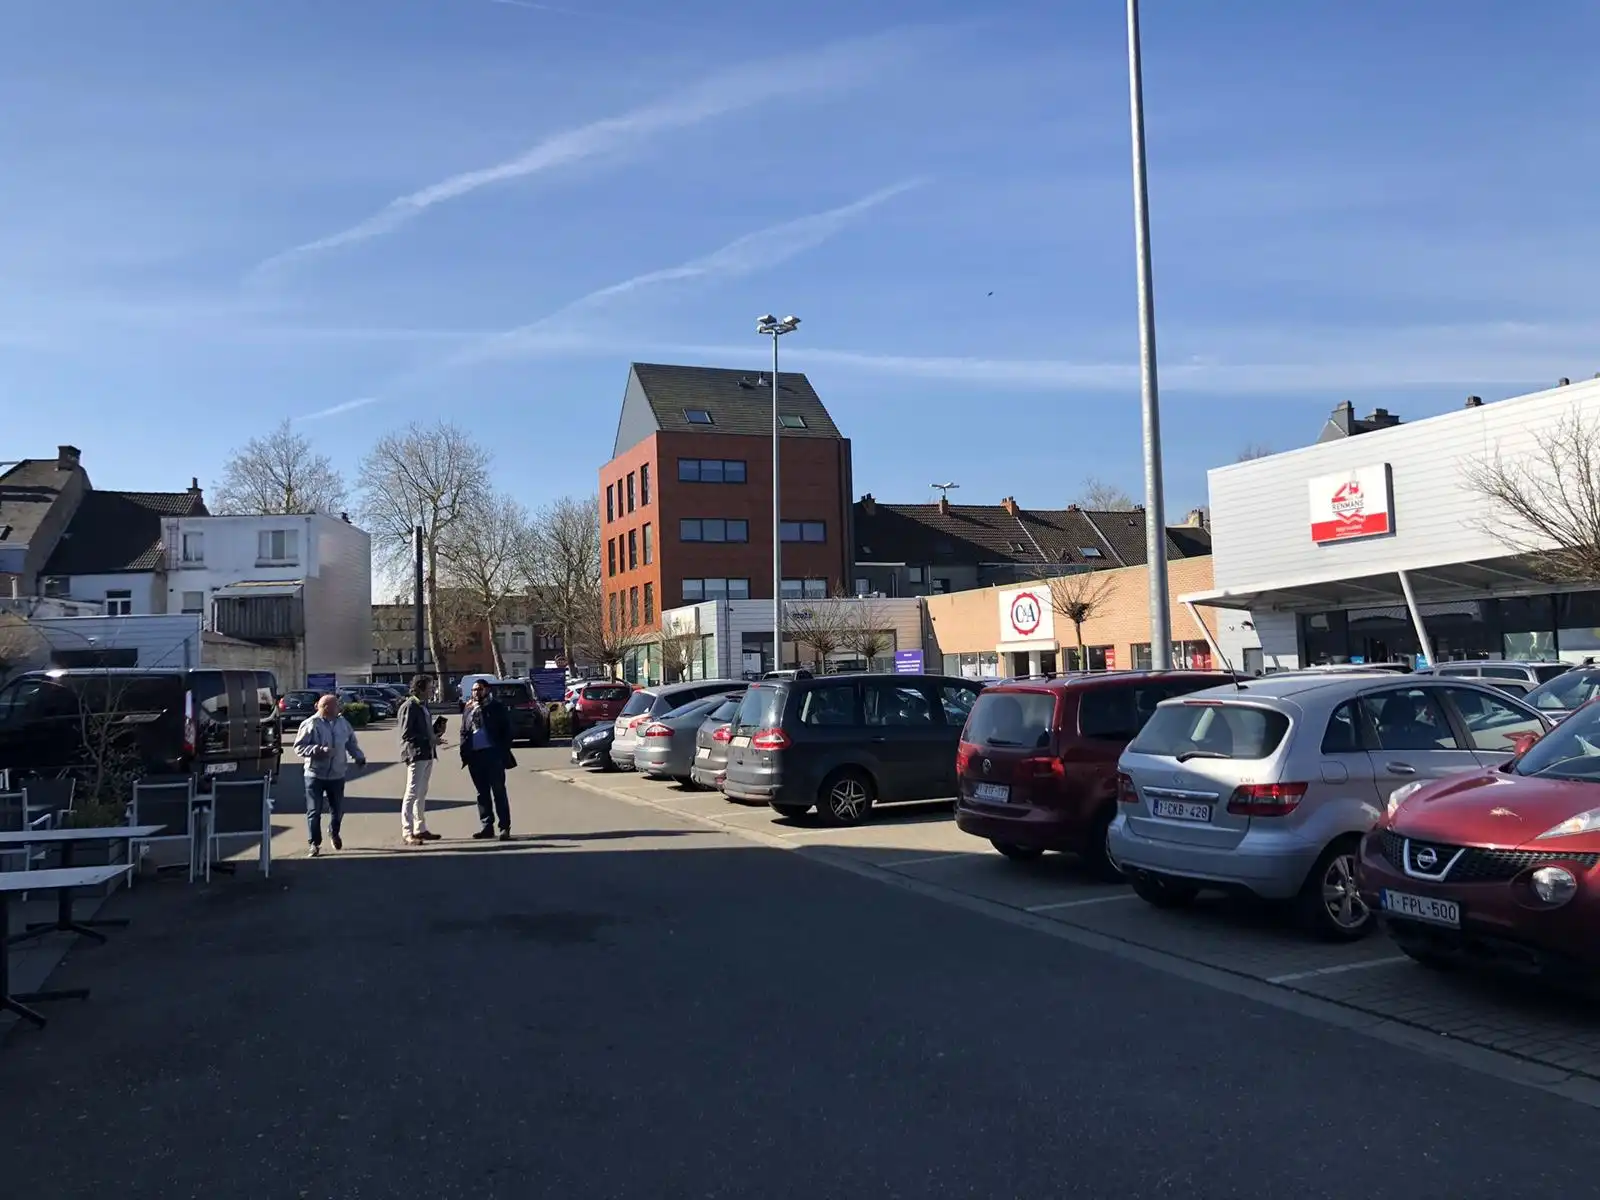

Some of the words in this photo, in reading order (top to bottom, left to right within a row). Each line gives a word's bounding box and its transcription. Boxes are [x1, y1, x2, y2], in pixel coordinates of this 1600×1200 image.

[1331, 499, 1364, 511] RENMANS
[1015, 603, 1036, 623] C&A
[1388, 893, 1457, 921] 1-FPL-500
